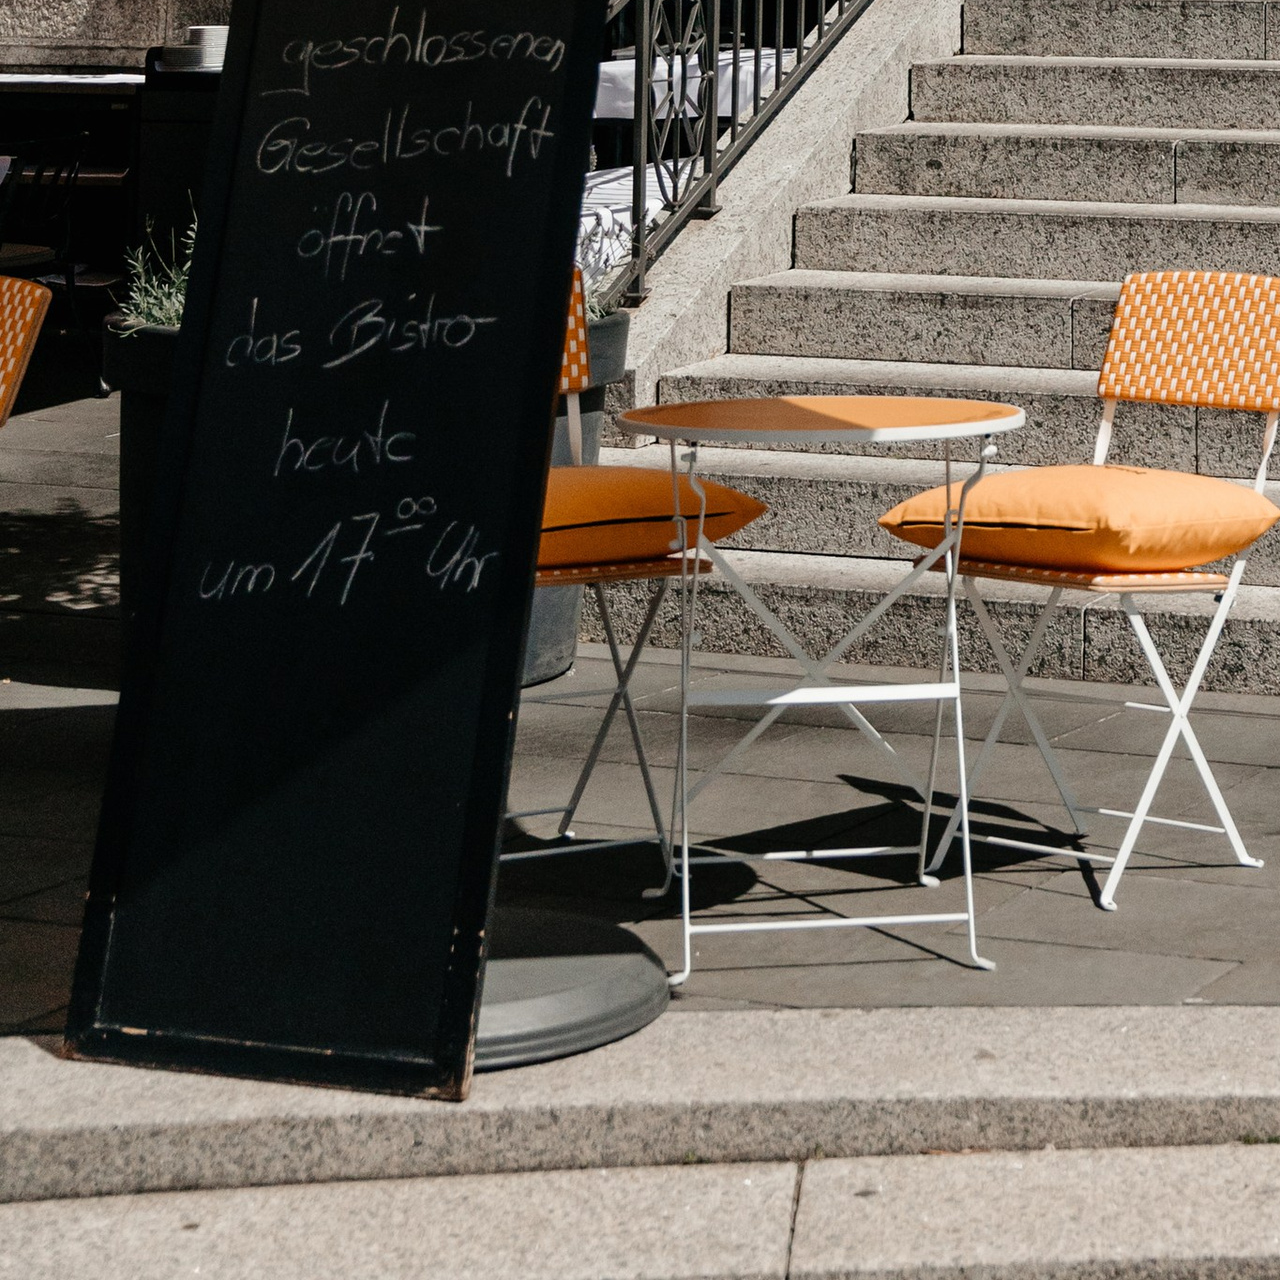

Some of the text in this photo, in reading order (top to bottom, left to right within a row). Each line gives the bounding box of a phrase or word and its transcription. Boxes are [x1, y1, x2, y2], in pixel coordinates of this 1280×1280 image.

[256, 95, 555, 179] Gesellschaft
[298, 191, 444, 282] öffnet
[225, 292, 499, 370] das Bistro
[273, 398, 417, 478] heute
[200, 559, 277, 601] um
[425, 519, 500, 594] Uhr
